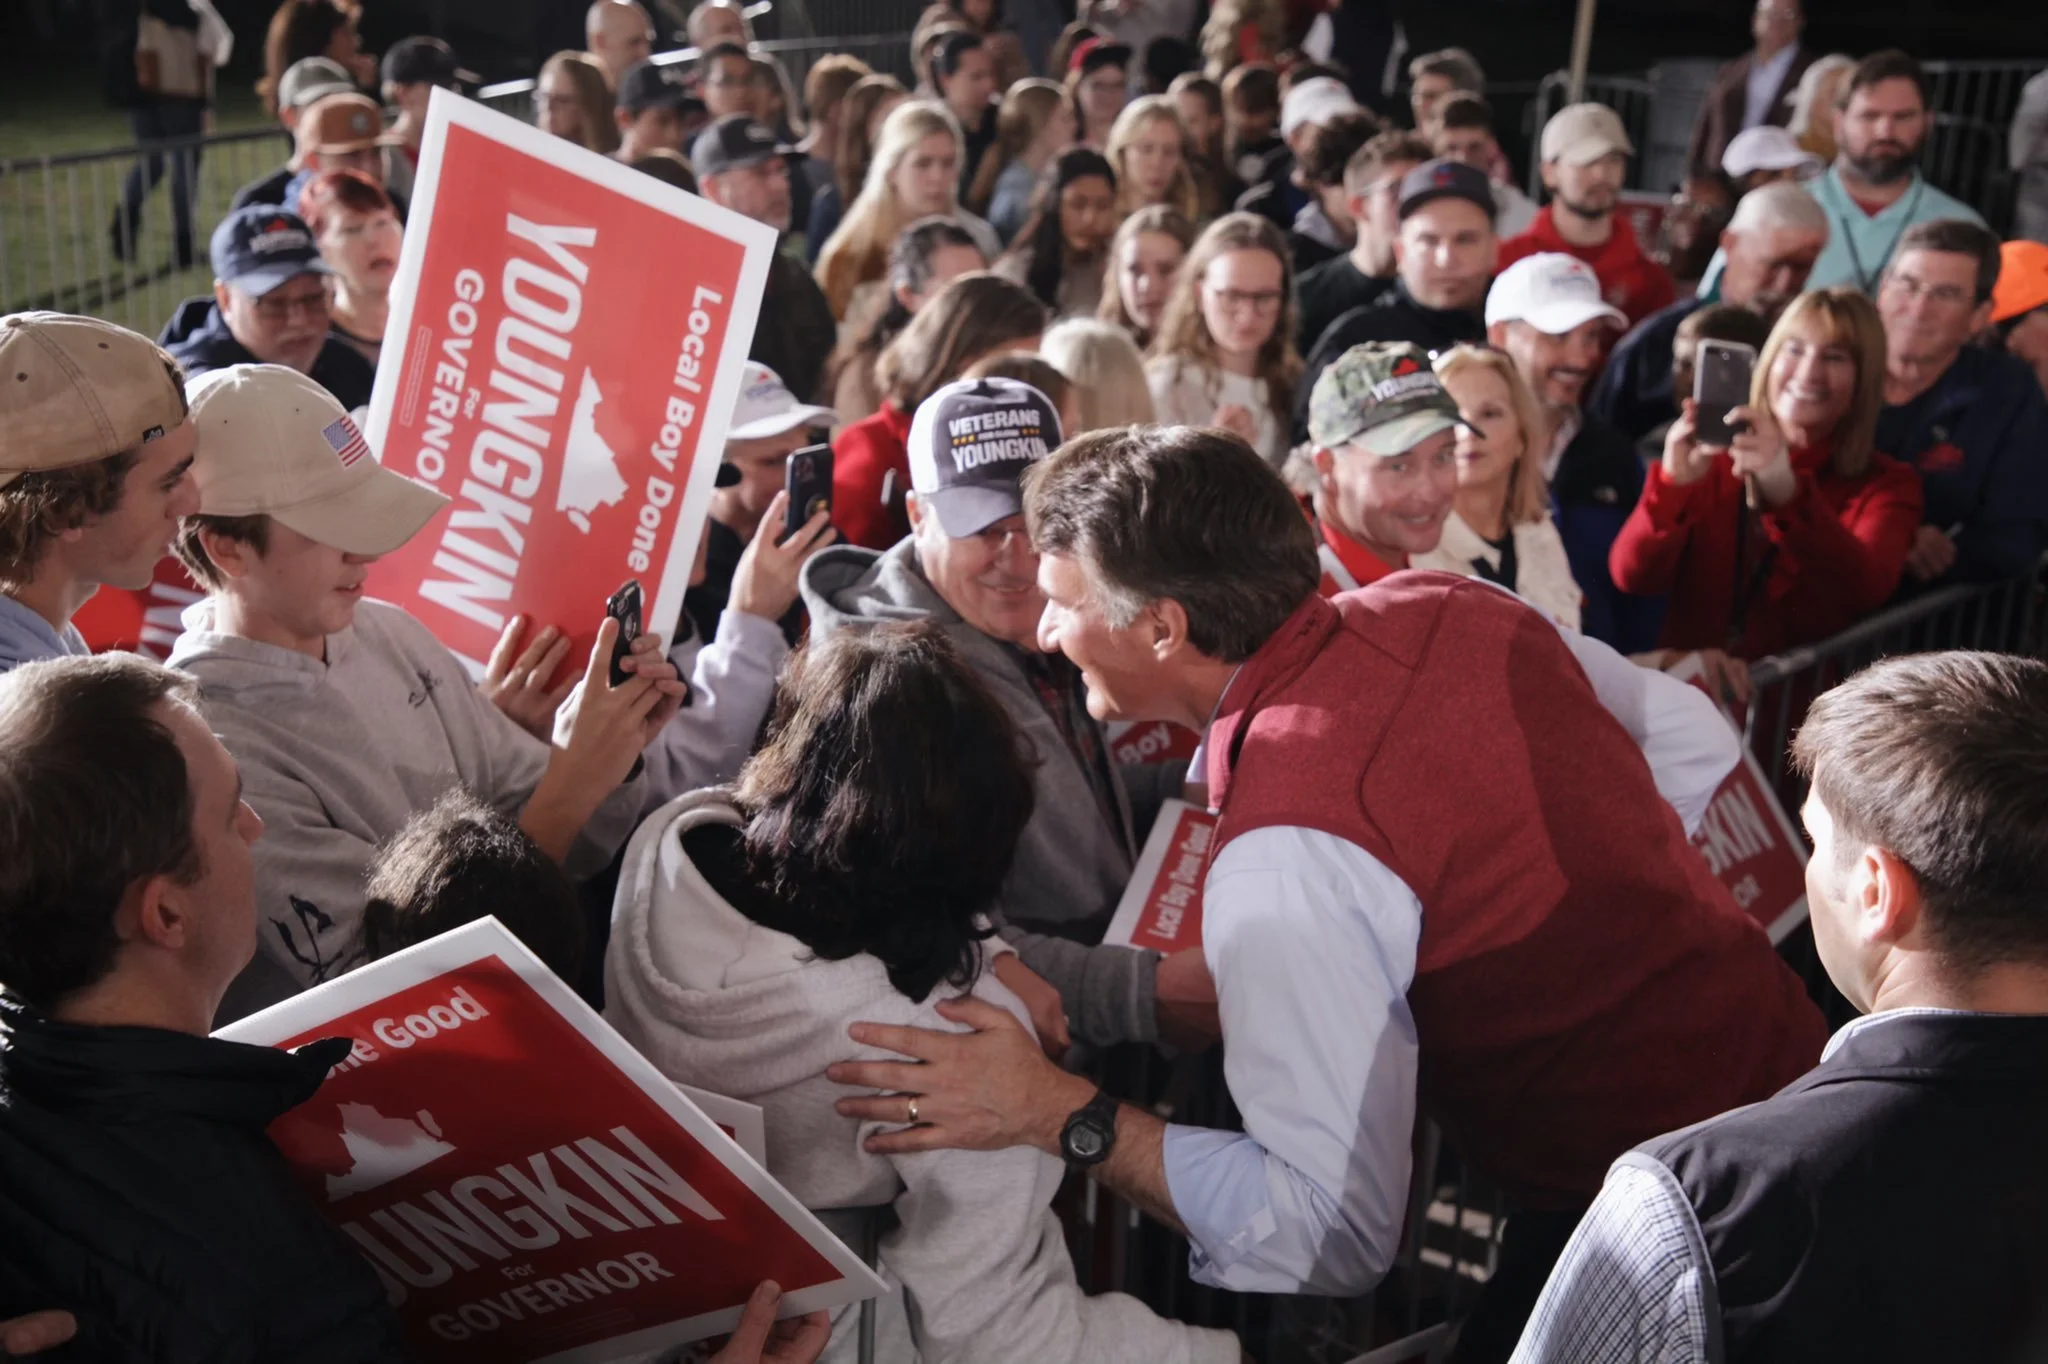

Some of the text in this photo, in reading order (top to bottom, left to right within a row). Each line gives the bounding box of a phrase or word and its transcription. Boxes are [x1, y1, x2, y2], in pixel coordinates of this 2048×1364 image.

[412, 268, 485, 492] GOVERNO
[462, 387, 481, 420] For
[418, 212, 598, 632] YOUNGKIN
[627, 285, 723, 573] Local Boy Done
[948, 408, 1040, 437] VETERANS
[1160, 883, 1197, 908] Boy
[1146, 903, 1184, 941] Local
[372, 985, 490, 1049] Good
[428, 1251, 676, 1342] GOVERNOR
[500, 1262, 536, 1281] For
